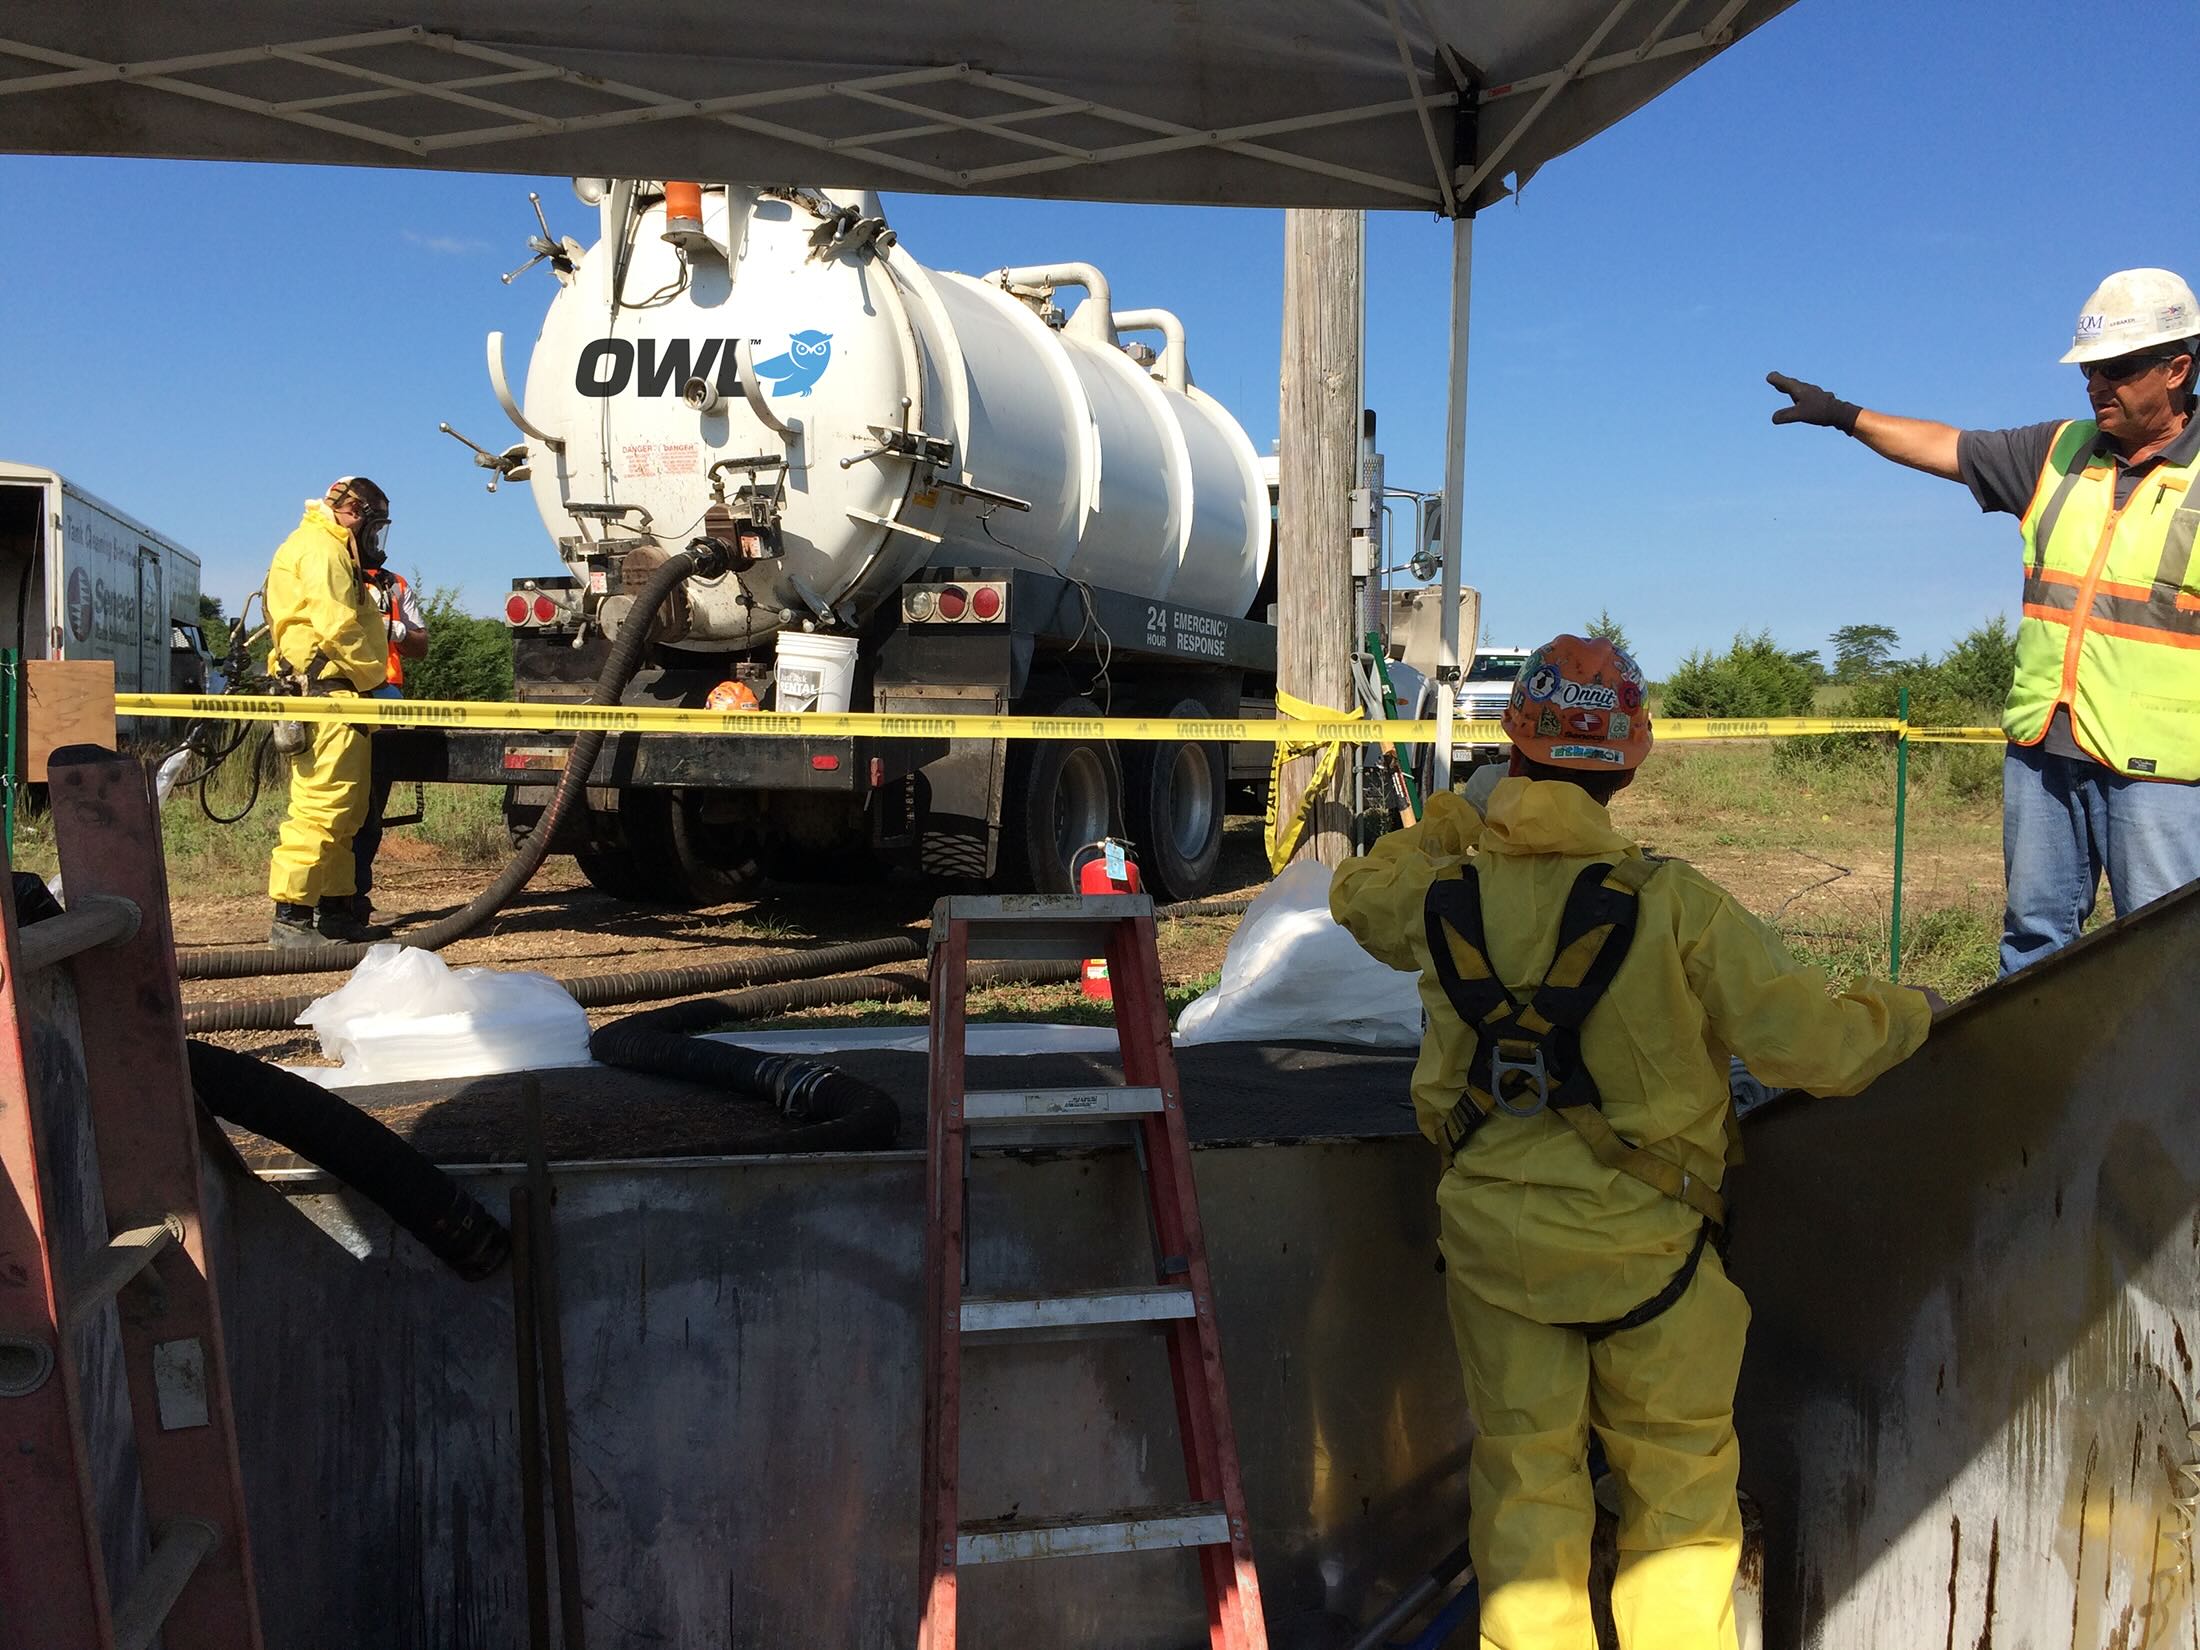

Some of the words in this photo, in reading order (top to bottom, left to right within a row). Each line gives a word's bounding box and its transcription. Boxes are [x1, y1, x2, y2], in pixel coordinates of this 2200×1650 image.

[575, 338, 758, 398] OWL
[622, 445, 652, 453] DANGER
[664, 444, 694, 452] DANGER
[1147, 606, 1167, 632] 24
[1173, 611, 1228, 638] EMERGENCY
[1146, 633, 1166, 648] HOUR
[1177, 632, 1225, 657] RESPONSE
[780, 682, 818, 695] RENTAL
[1563, 684, 1616, 705] Onnit
